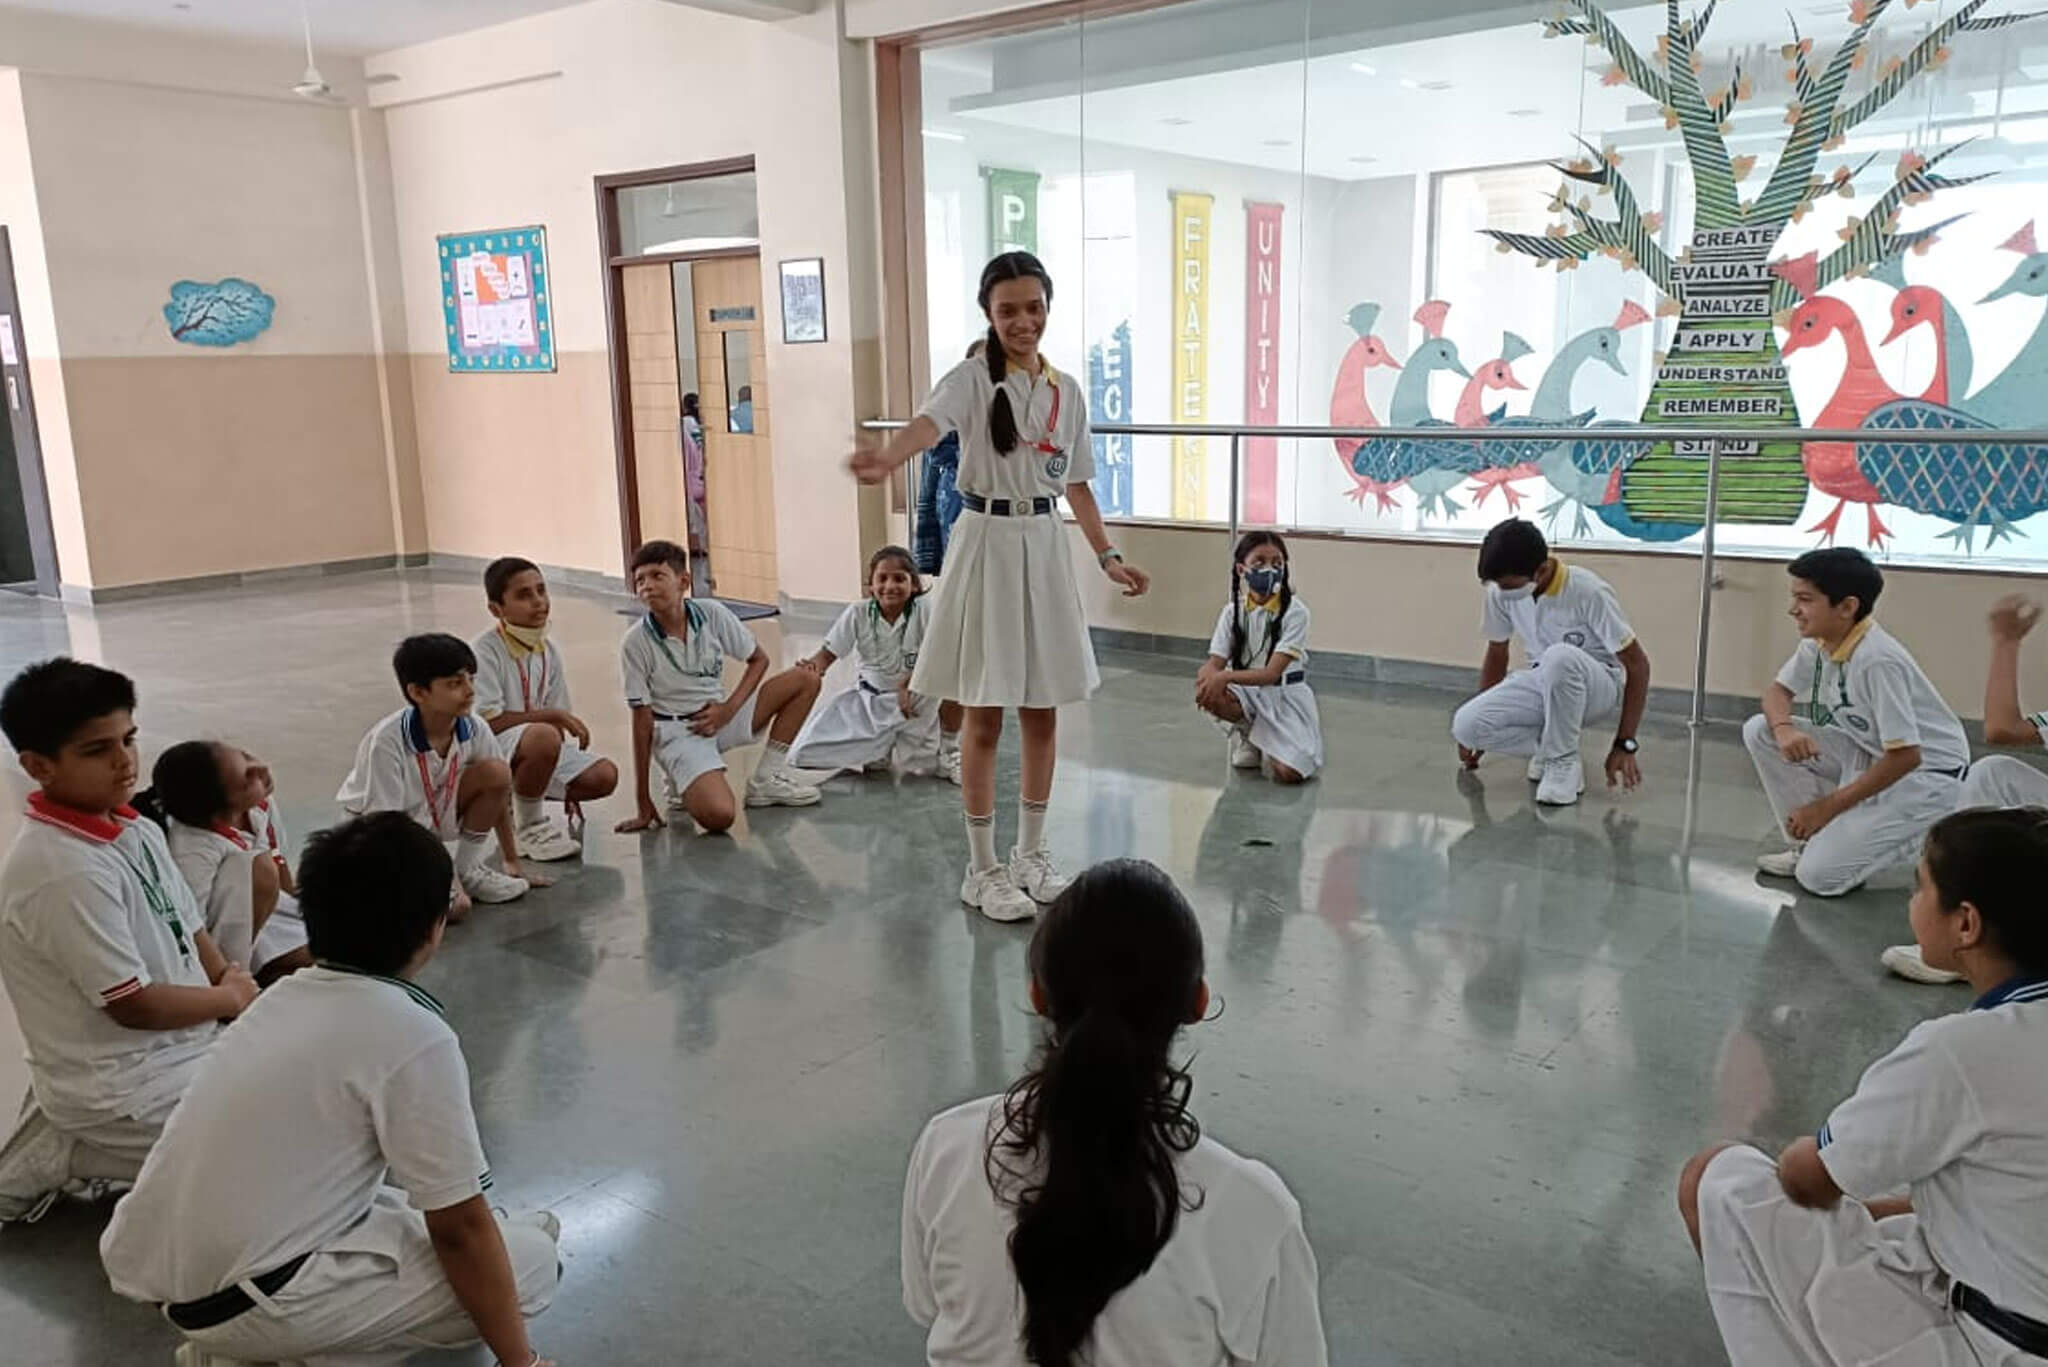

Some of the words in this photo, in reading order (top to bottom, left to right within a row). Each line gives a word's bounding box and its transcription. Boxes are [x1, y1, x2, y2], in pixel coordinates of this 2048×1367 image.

[1688, 299, 1764, 313] ANALYZE
[1258, 221, 1273, 408] UNITY
[1689, 333, 1755, 348] APPLY
[1658, 367, 1787, 381] UNDERSTAND
[1663, 399, 1778, 413] REMEMBER
[1682, 439, 1749, 451] STND
